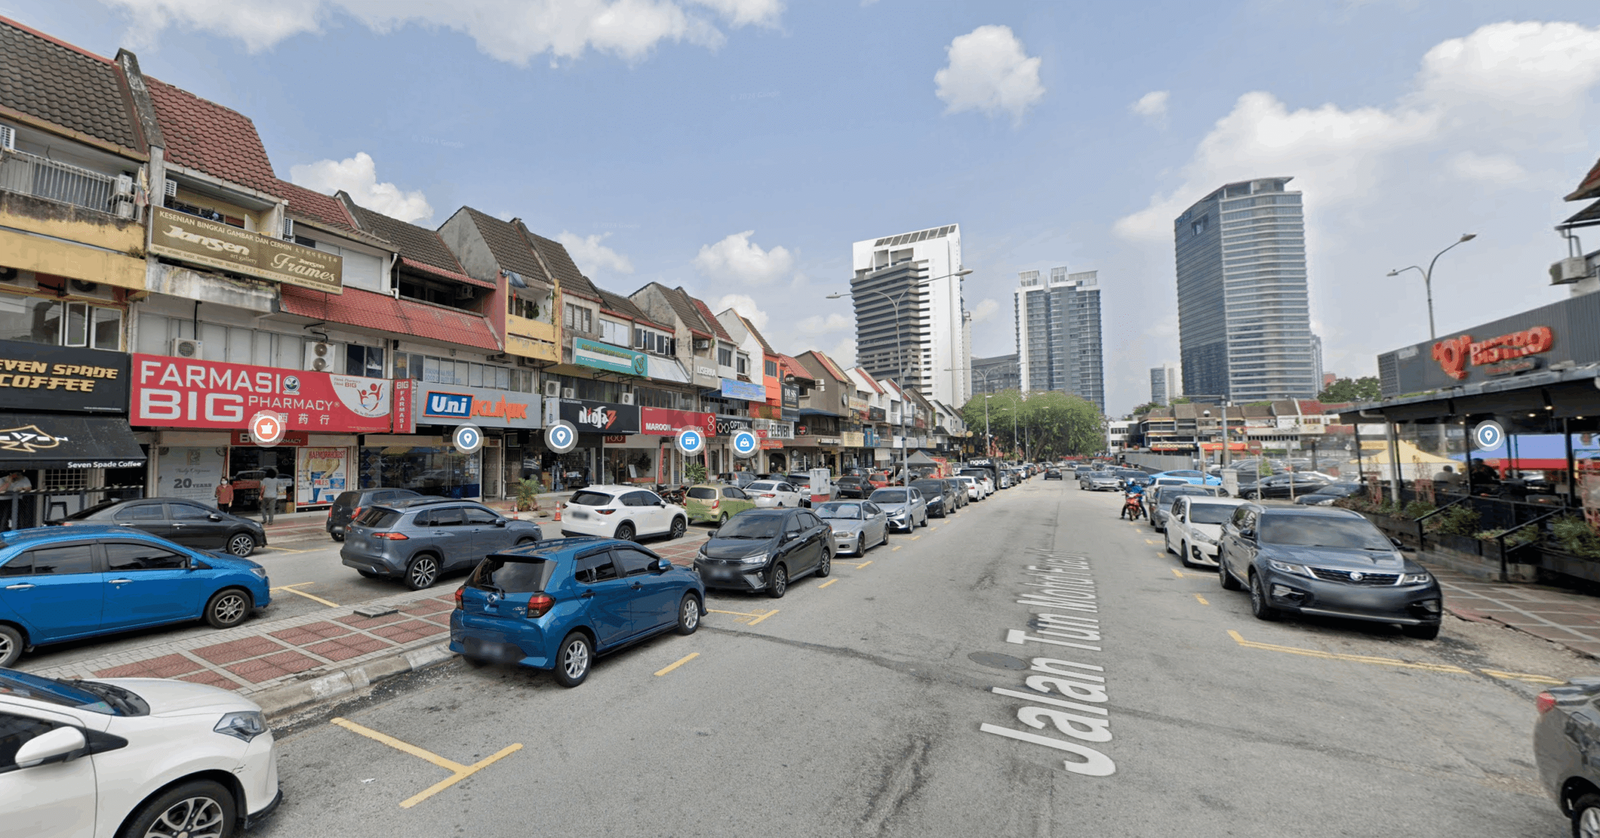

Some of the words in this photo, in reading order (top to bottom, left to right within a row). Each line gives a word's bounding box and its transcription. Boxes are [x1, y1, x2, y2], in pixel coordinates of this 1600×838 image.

[159, 210, 195, 226] KESENIAN
[196, 220, 226, 234] BINGKAI
[226, 228, 253, 241] GAMBAR
[254, 236, 269, 245] DAN
[270, 241, 292, 251] CERMIN
[162, 224, 250, 256] Jansen
[270, 252, 336, 282] Frames
[1470, 326, 1553, 366] BISTRO
[0, 358, 48, 374] VEN
[52, 363, 119, 380] SPADE
[0, 373, 96, 393] COFFEE
[140, 360, 281, 394] FARMASI
[396, 381, 409, 390] BIG
[139, 387, 244, 423] BIG
[431, 395, 468, 414] Uni
[472, 394, 529, 424] KLINIK
[67, 461, 92, 469] Seven
[93, 461, 116, 469] Spade
[118, 460, 142, 468] Coffee
[173, 478, 192, 489] 20
